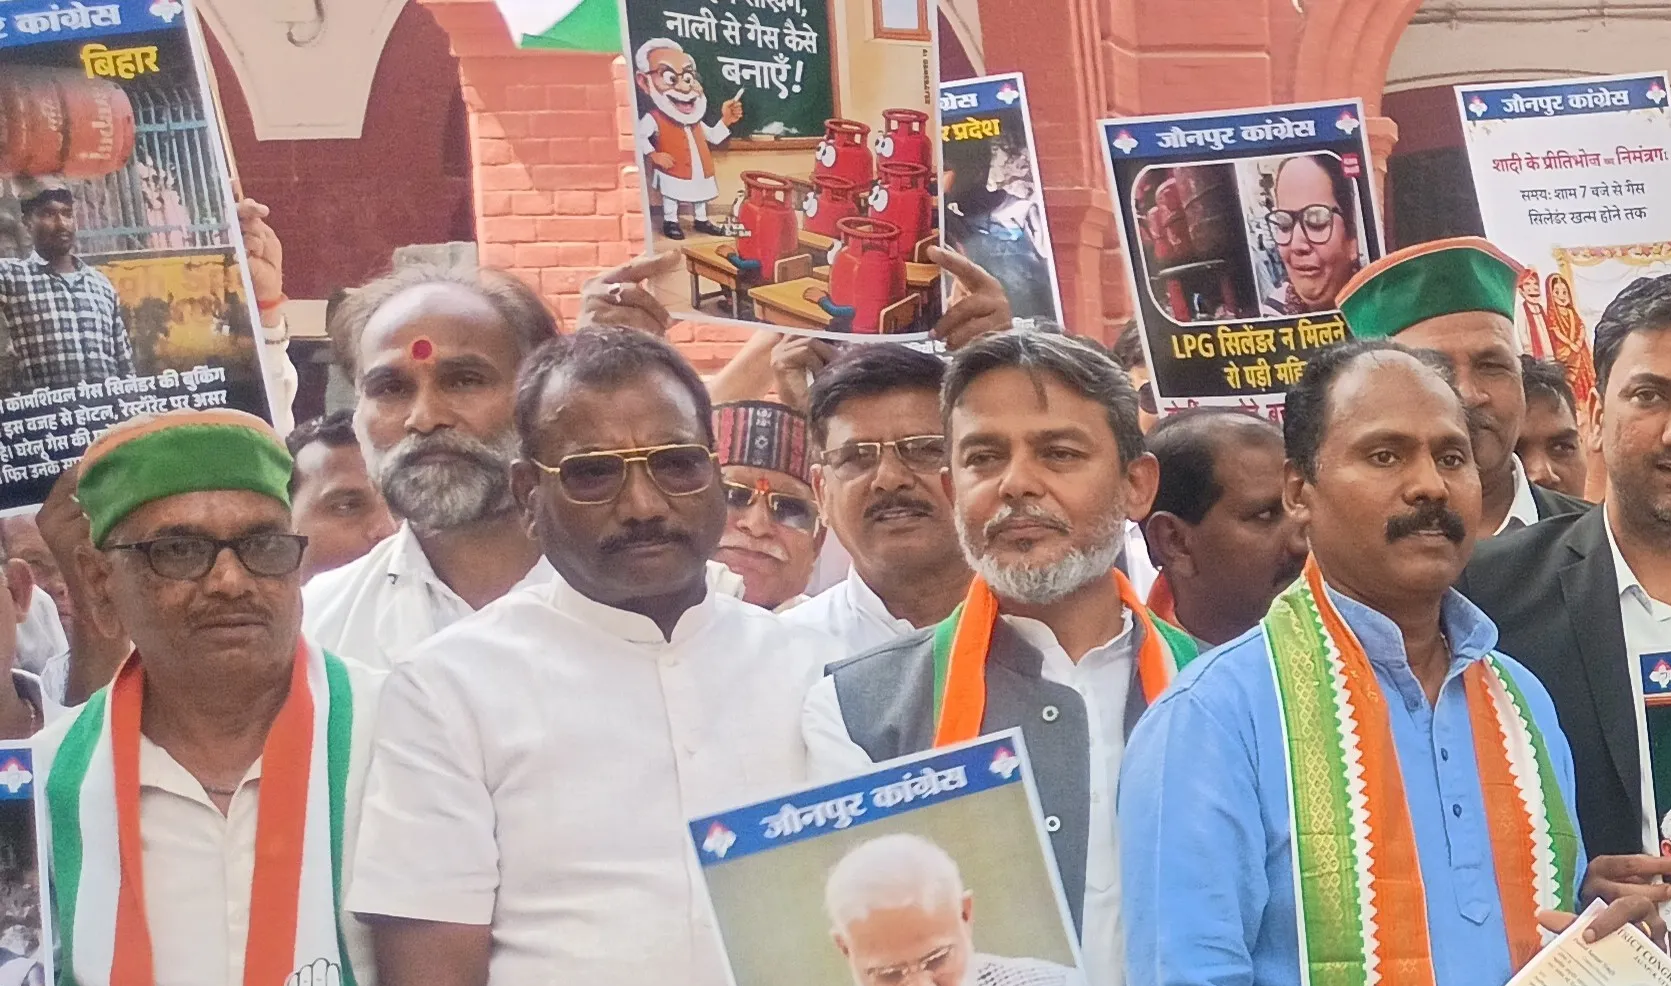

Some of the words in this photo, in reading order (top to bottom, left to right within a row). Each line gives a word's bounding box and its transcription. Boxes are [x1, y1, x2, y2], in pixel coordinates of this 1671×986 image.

[15, 1, 121, 34] कांग्रेस
[663, 6, 718, 42] नाली
[720, 12, 742, 46] से
[744, 13, 780, 50] गैस
[783, 18, 818, 54] कैसे
[80, 43, 160, 79] बिहार
[1501, 94, 1564, 116] जौनपुर
[1567, 87, 1629, 109] कांग्रेस
[951, 117, 1000, 141] प्रदेश
[1155, 126, 1238, 150] जौनपुर
[1240, 117, 1316, 142] कांग्रेस
[1492, 153, 1522, 175] शादी
[1525, 152, 1540, 170] के
[1541, 148, 1600, 171] प्रीतिभोज
[1554, 188, 1577, 200] शाम
[1579, 185, 1587, 199] 7
[1590, 181, 1610, 198] बजे
[1611, 180, 1623, 196] से
[1568, 211, 1597, 224] खत्म
[1599, 205, 1622, 223] होने
[1623, 206, 1648, 220] तक
[1171, 334, 1215, 359] LPG
[1217, 325, 1277, 358] सिलेंडर
[1279, 327, 1294, 350] न
[1297, 315, 1346, 349] मिलने
[78, 379, 103, 399] गैस
[105, 374, 156, 396] सिलेंडर
[157, 368, 179, 388] की
[182, 365, 226, 392] बुकिंग
[1223, 361, 1242, 390] रो
[1243, 358, 1273, 392] पड़ी
[3, 418, 25, 438] इस
[26, 414, 57, 432] वजह
[59, 409, 73, 426] से
[75, 404, 119, 425] होटल,
[169, 394, 189, 409] पर
[192, 389, 227, 408] असर
[15, 437, 50, 463] घरेलू
[47, 433, 69, 453] गैस
[71, 427, 93, 448] की
[2, 463, 29, 485] फिर
[30, 458, 62, 480] उनके
[759, 792, 867, 839] जौनपुर
[869, 765, 968, 808] कांग्रेस
